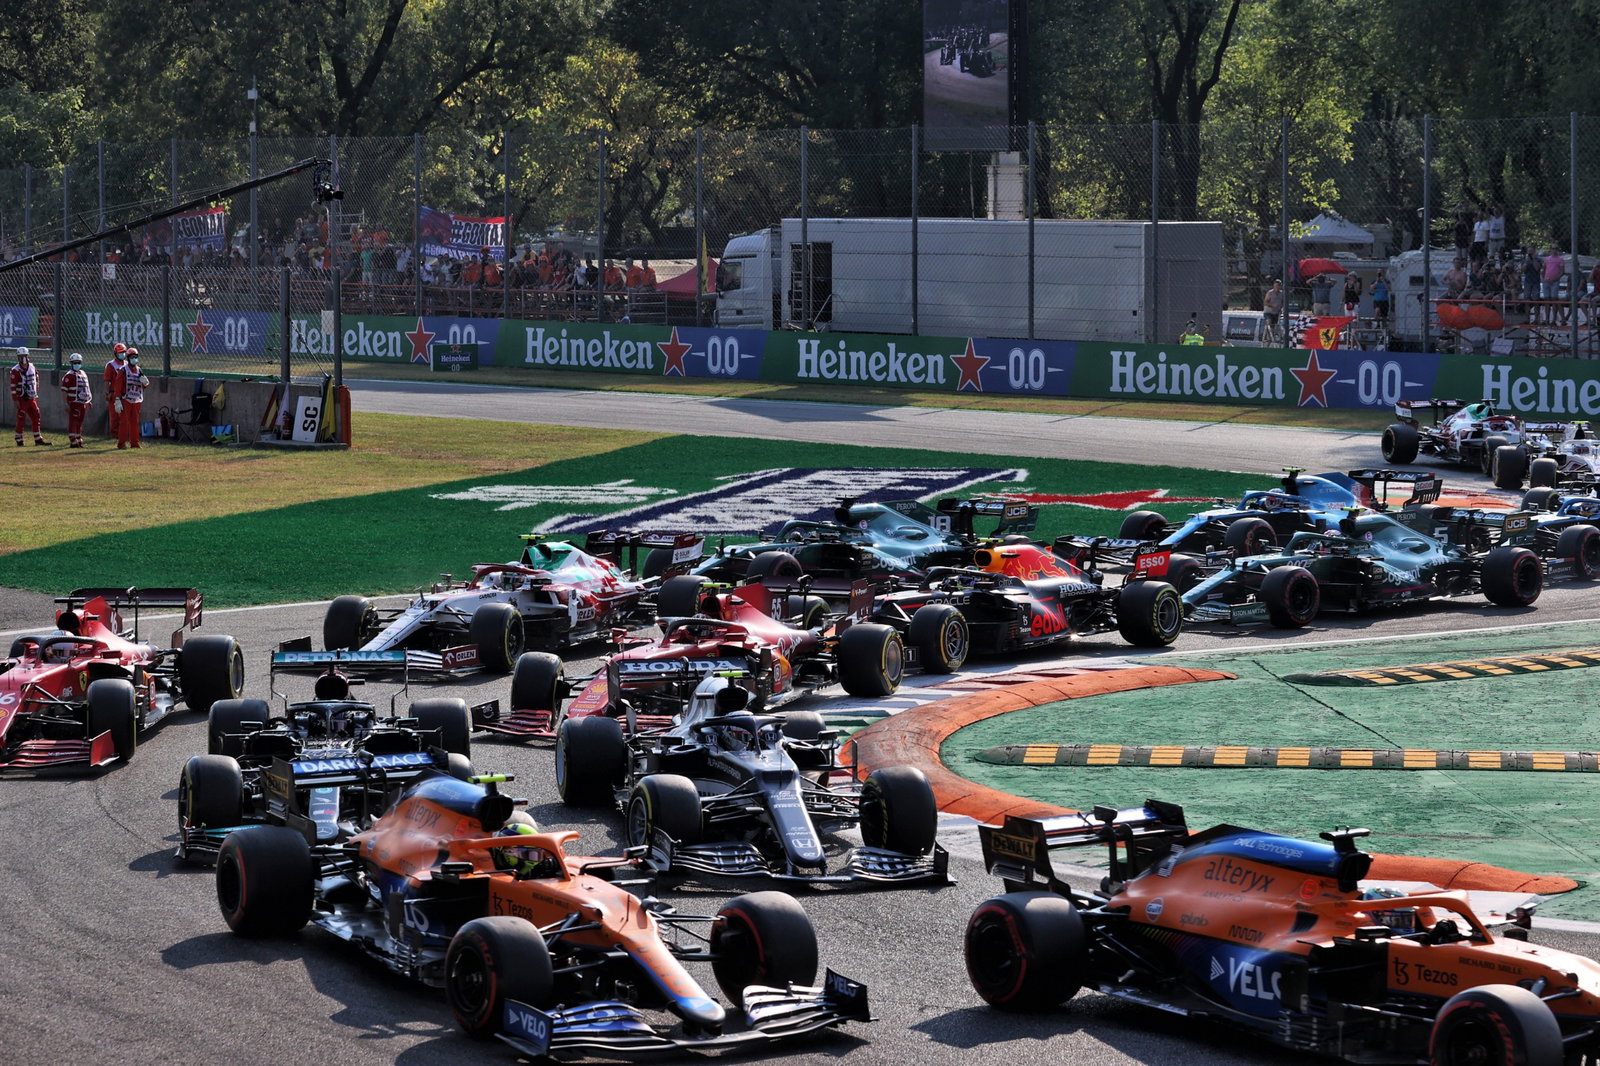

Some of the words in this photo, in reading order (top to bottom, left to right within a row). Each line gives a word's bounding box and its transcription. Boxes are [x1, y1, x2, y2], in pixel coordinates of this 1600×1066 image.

[449, 323, 477, 344] 00
[525, 326, 654, 370] Heineken
[706, 335, 739, 375] 0.0
[441, 353, 471, 363] Heineken
[797, 338, 946, 384] Heineken
[1007, 347, 1046, 390] 0.0
[1109, 349, 1285, 400] Heineken
[1357, 359, 1402, 406] 0.0
[302, 405, 319, 433] SC
[896, 502, 917, 511] PERONI
[1006, 506, 1028, 517] JCB
[1396, 512, 1417, 521] PERONI
[927, 515, 951, 533] 18
[1507, 520, 1527, 529] JCB
[1434, 526, 1449, 545] 5
[1140, 546, 1156, 555] Claro
[1139, 555, 1165, 569] ESSO
[1059, 582, 1096, 593] HONDA
[926, 596, 970, 606] ORACLE
[577, 608, 595, 620] RLEN
[771, 597, 782, 621] 55
[284, 651, 393, 662] PETRONAS
[456, 650, 475, 661] ORLEN
[624, 660, 734, 672] HONDA
[0, 692, 16, 705] 6
[301, 753, 431, 774] DARKRACE
[1233, 837, 1255, 848] DELL
[1204, 857, 1275, 892] alteryx
[506, 898, 534, 920] Tezos
[1458, 956, 1496, 970] RICHARD
[1497, 963, 1523, 976] MILLE
[1415, 963, 1459, 986] Tezos
[520, 1010, 546, 1039] VELO
